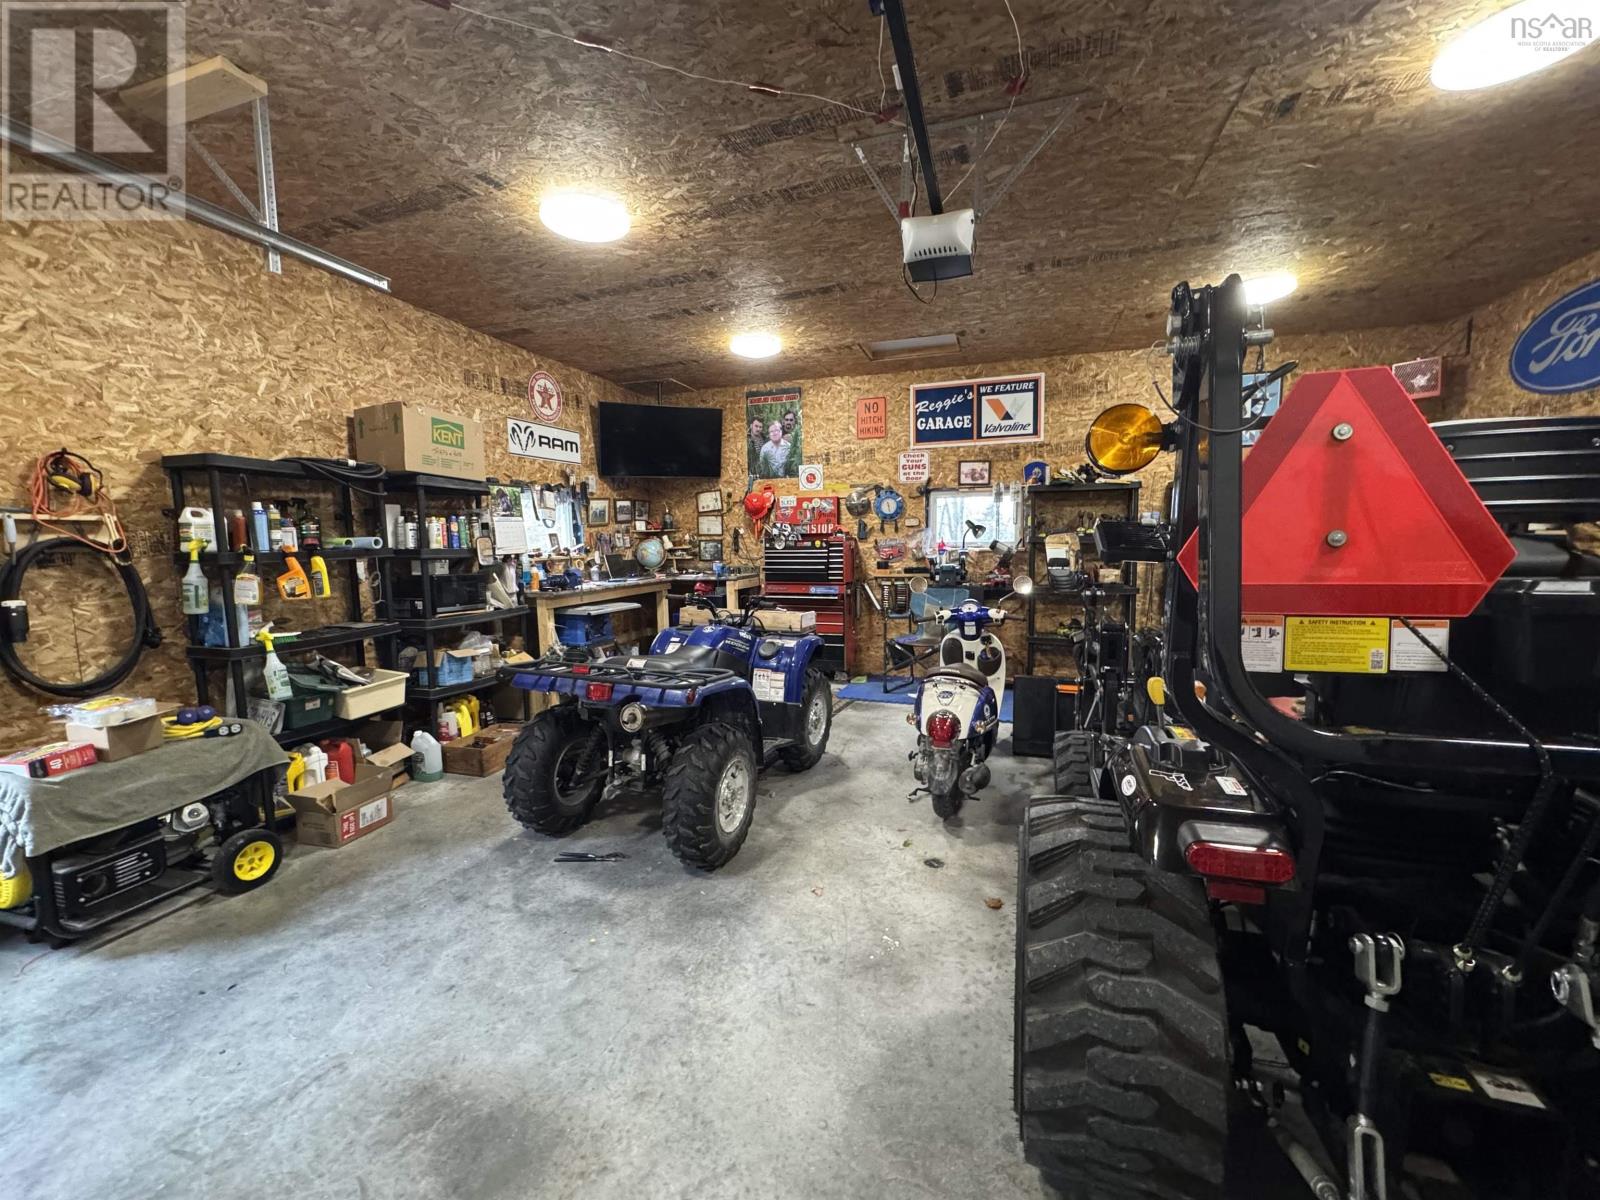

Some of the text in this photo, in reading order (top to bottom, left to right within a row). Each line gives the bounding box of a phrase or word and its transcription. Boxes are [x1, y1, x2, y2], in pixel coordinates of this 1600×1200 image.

[1528, 301, 1600, 374] For
[979, 382, 1035, 394] WE FEATURE
[864, 402, 879, 414] NO
[915, 388, 974, 416] Reggie's
[860, 416, 883, 425] HITCH
[916, 415, 972, 430] GARAGE
[859, 425, 884, 435] HIKING
[984, 422, 1031, 434] Valvoline
[432, 427, 464, 447] KENT
[538, 434, 579, 454] RAM
[901, 463, 927, 471] GUNS
